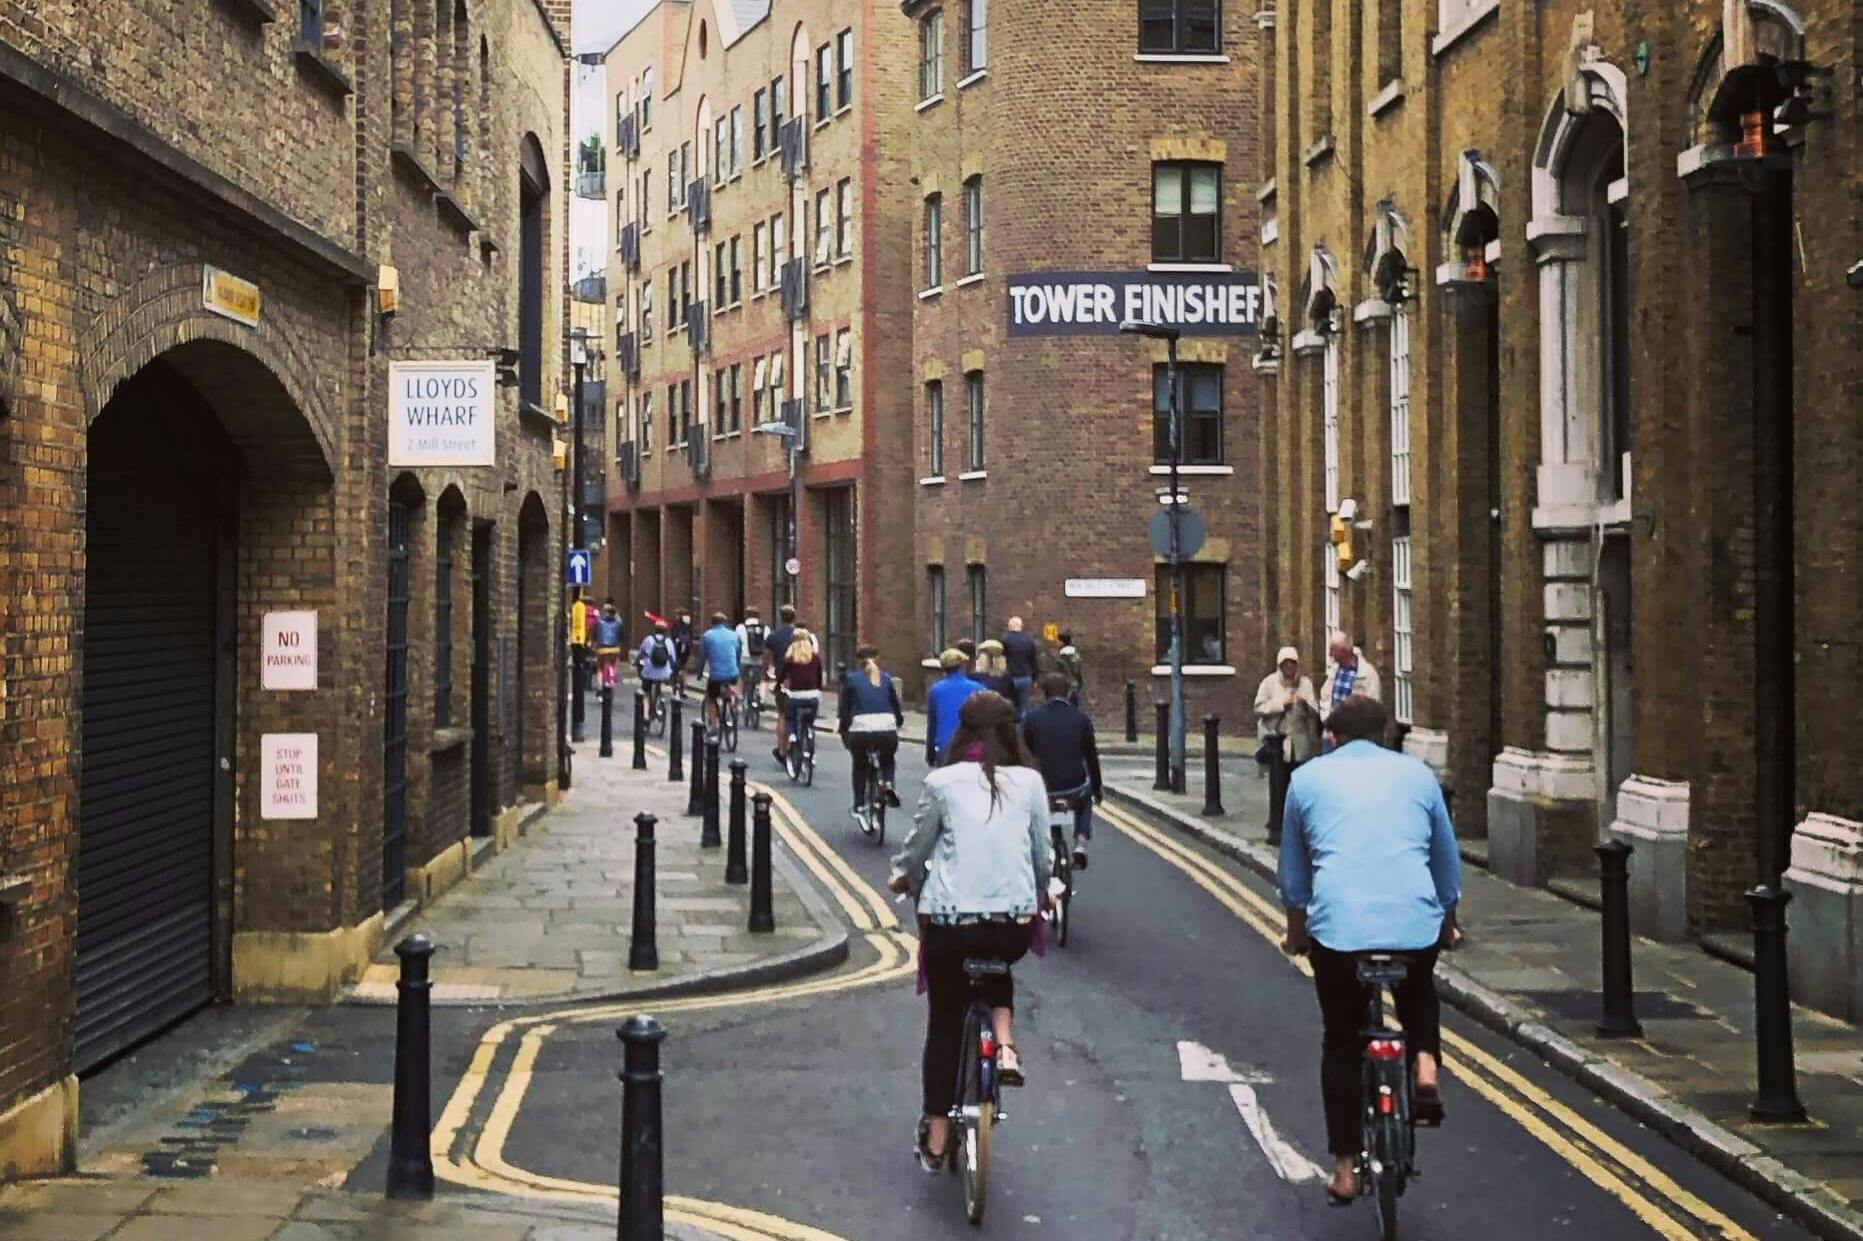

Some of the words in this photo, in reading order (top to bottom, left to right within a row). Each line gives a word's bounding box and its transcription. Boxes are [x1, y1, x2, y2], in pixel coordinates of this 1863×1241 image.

[1009, 284, 1117, 324] TOWER
[407, 378, 478, 399] LLOYDS
[407, 405, 477, 426] WHARF
[278, 631, 300, 648] NO
[267, 655, 311, 667] PARKING
